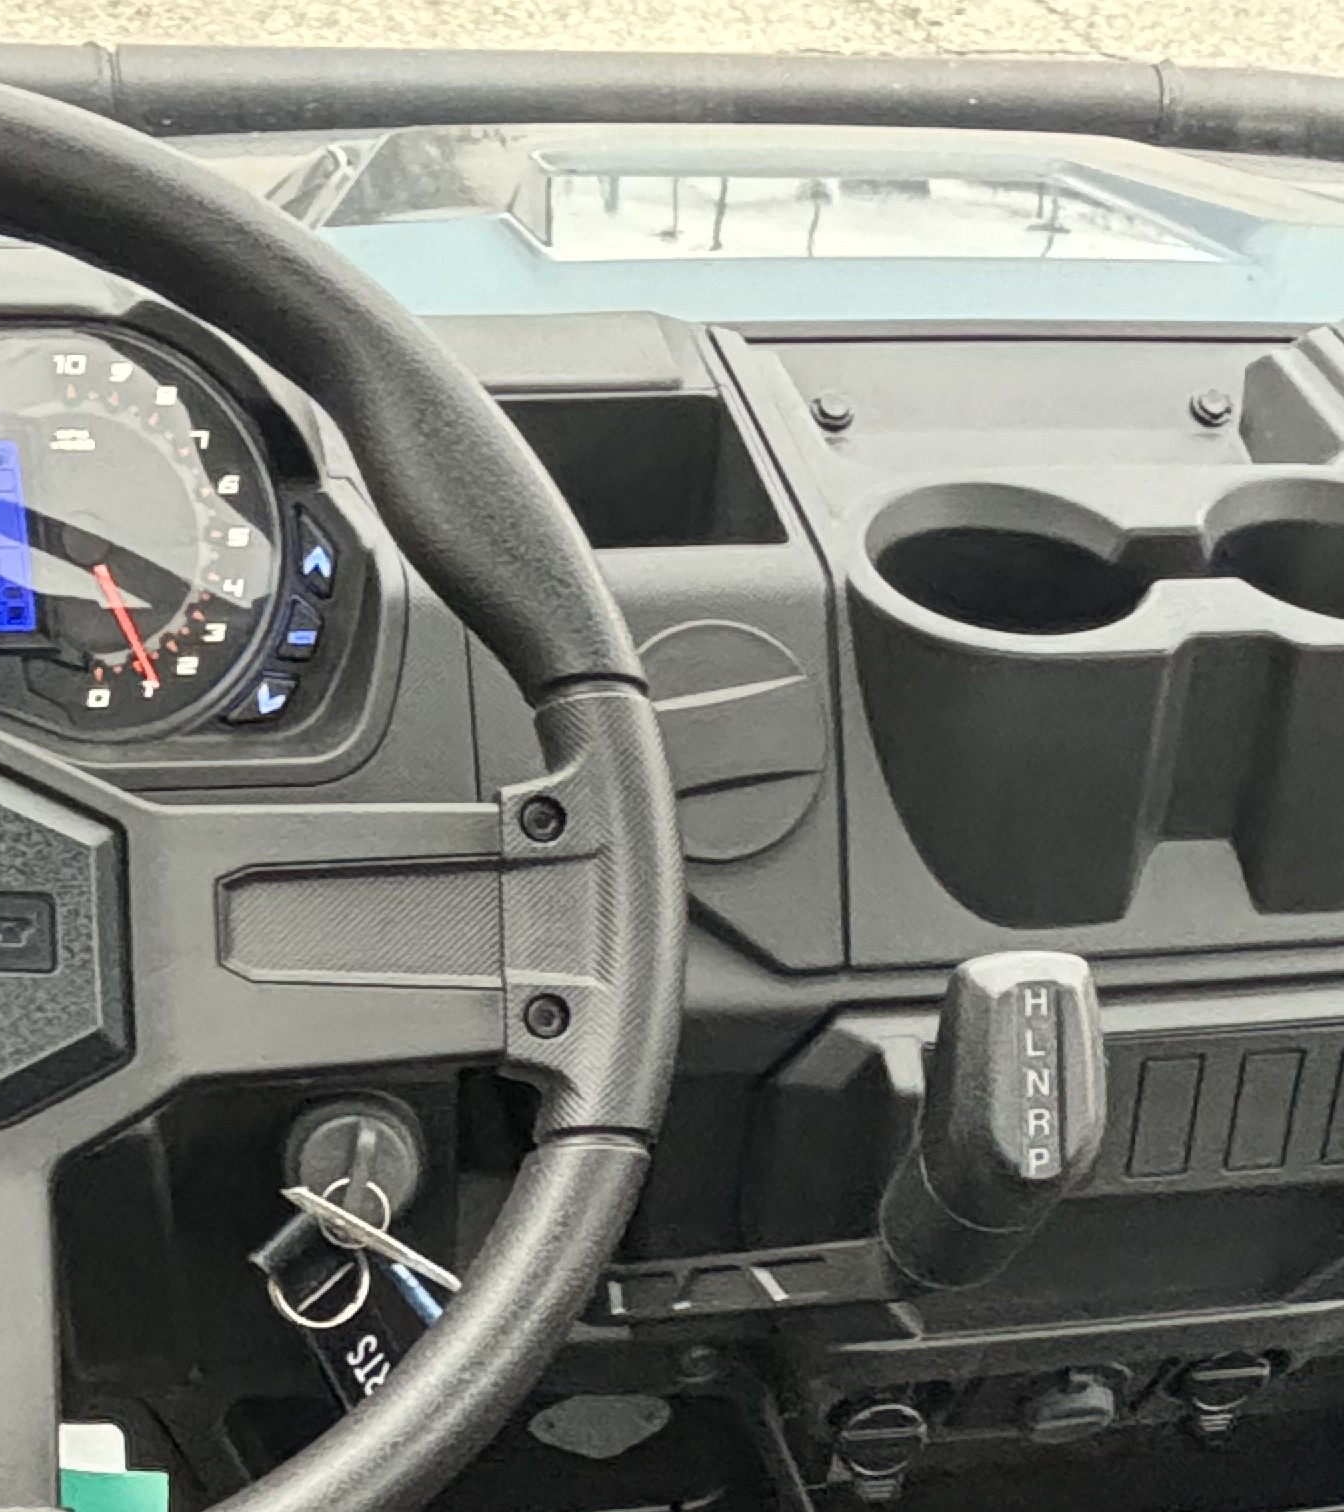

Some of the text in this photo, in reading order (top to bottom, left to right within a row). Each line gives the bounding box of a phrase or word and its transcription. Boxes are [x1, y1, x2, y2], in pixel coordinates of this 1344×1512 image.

[52, 354, 88, 376] 10
[189, 430, 211, 450] 7
[217, 474, 241, 495] 6
[222, 578, 244, 598] 4
[202, 622, 227, 642] 3
[176, 656, 199, 676] 2
[86, 688, 111, 708] 0
[1024, 987, 1051, 1177] H L N R P
